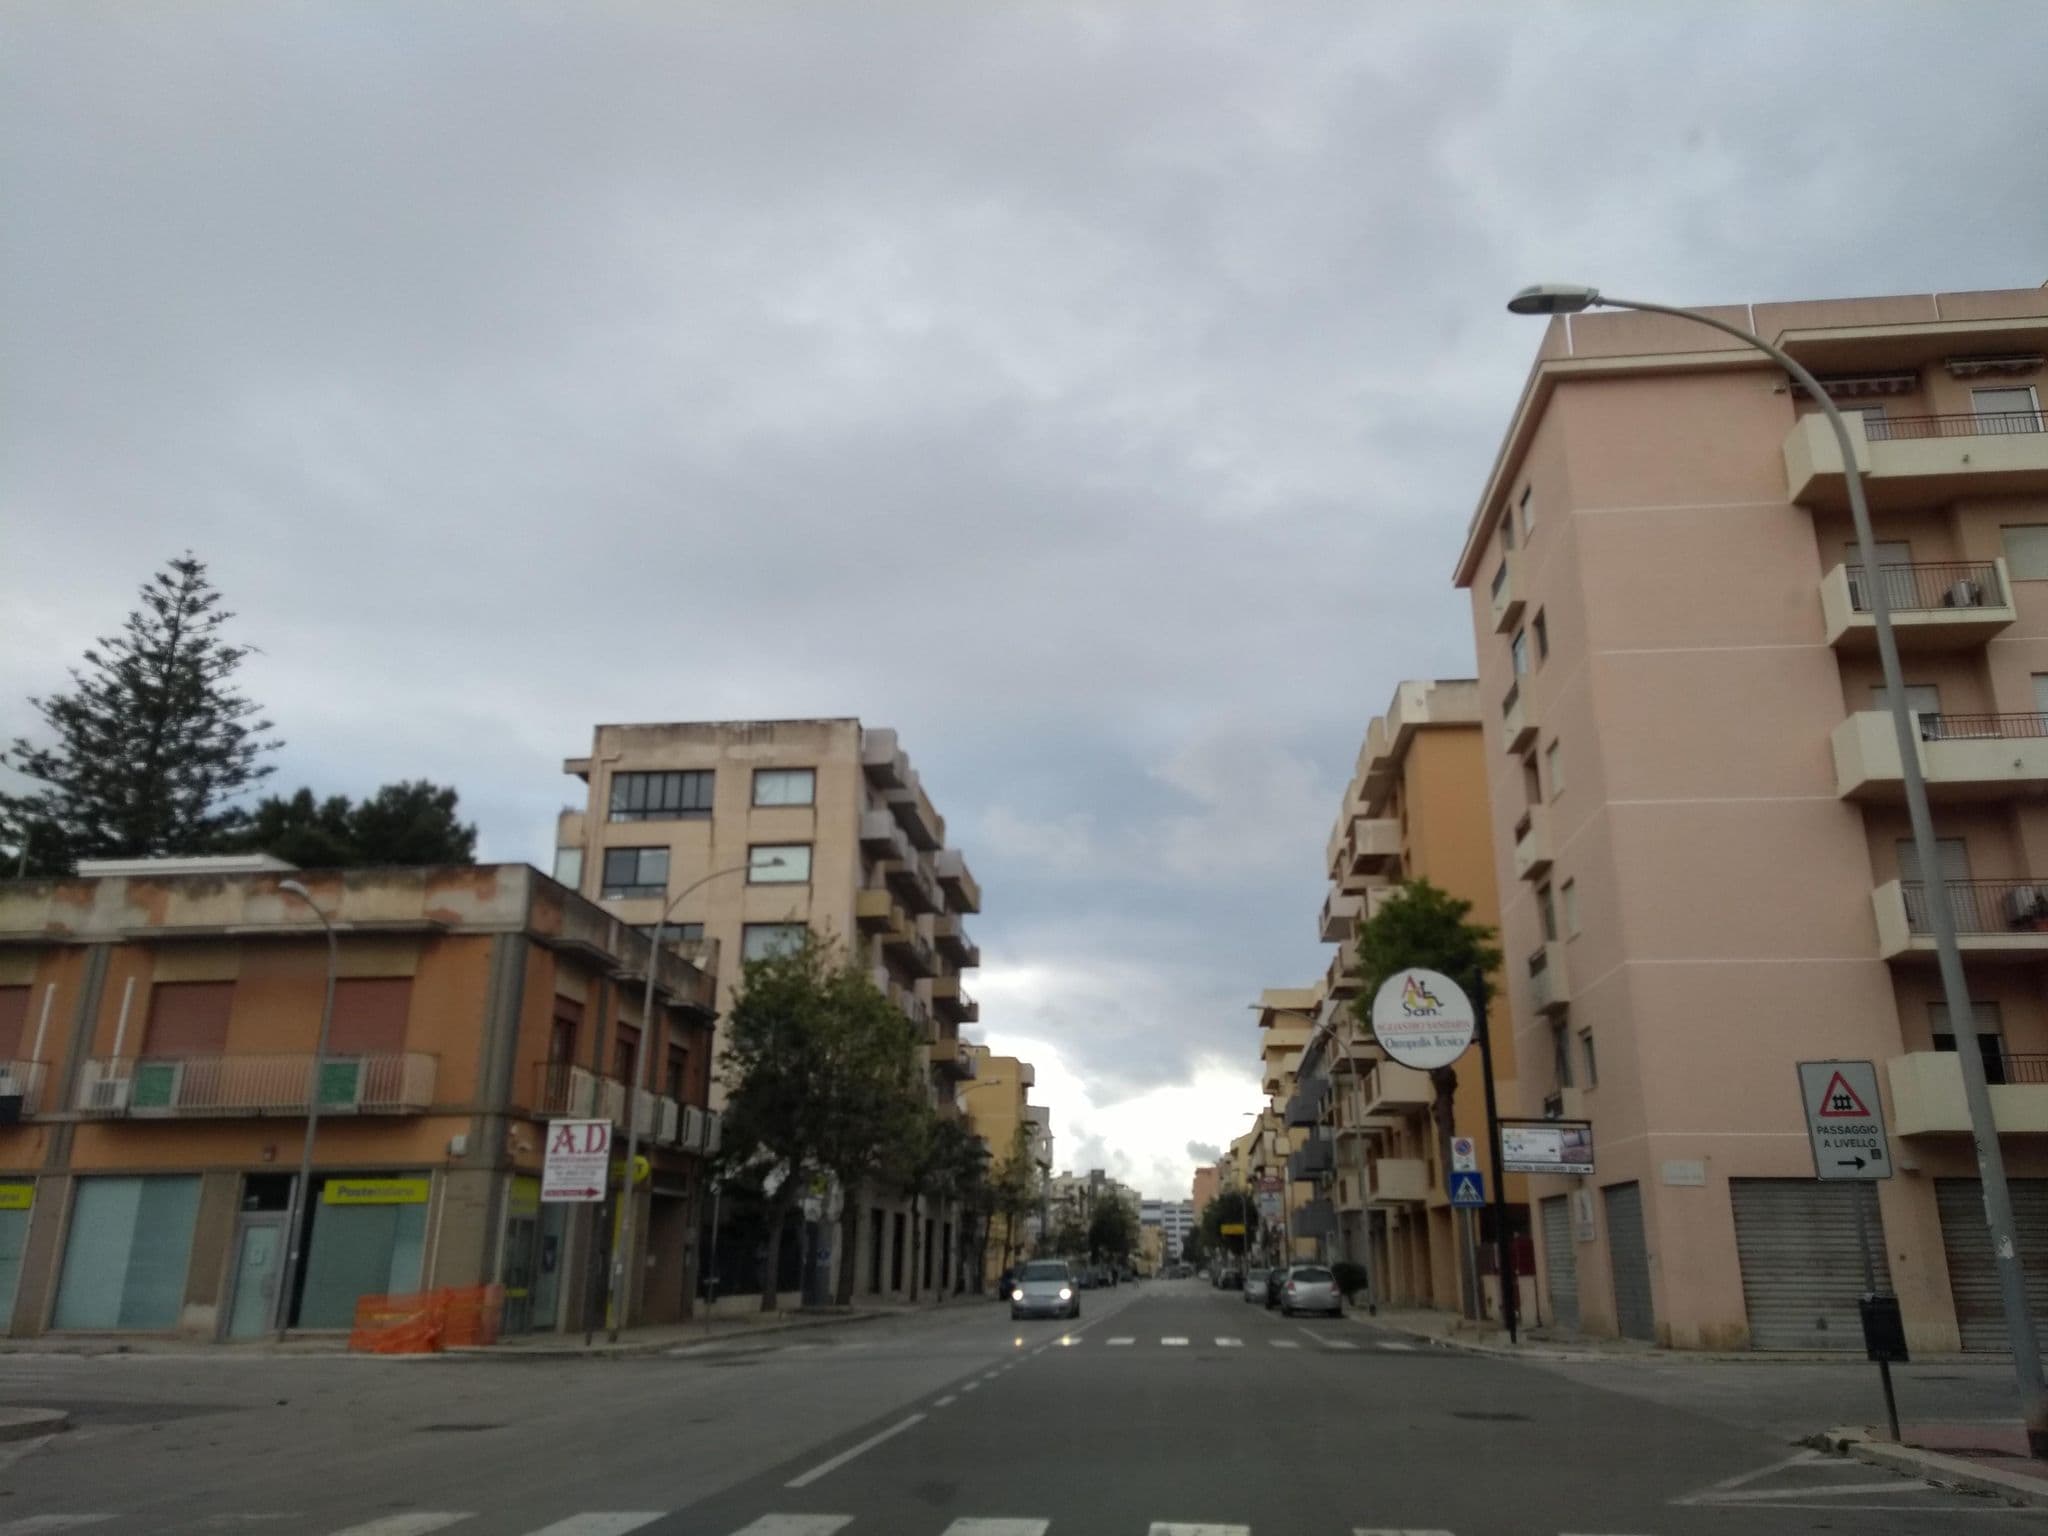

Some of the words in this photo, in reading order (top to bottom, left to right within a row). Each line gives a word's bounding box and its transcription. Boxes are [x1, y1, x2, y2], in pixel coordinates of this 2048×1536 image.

[1816, 1125, 1879, 1136] PASSAGGIO
[1823, 1139, 1832, 1149] A
[1834, 1138, 1877, 1148] LIVELLO
